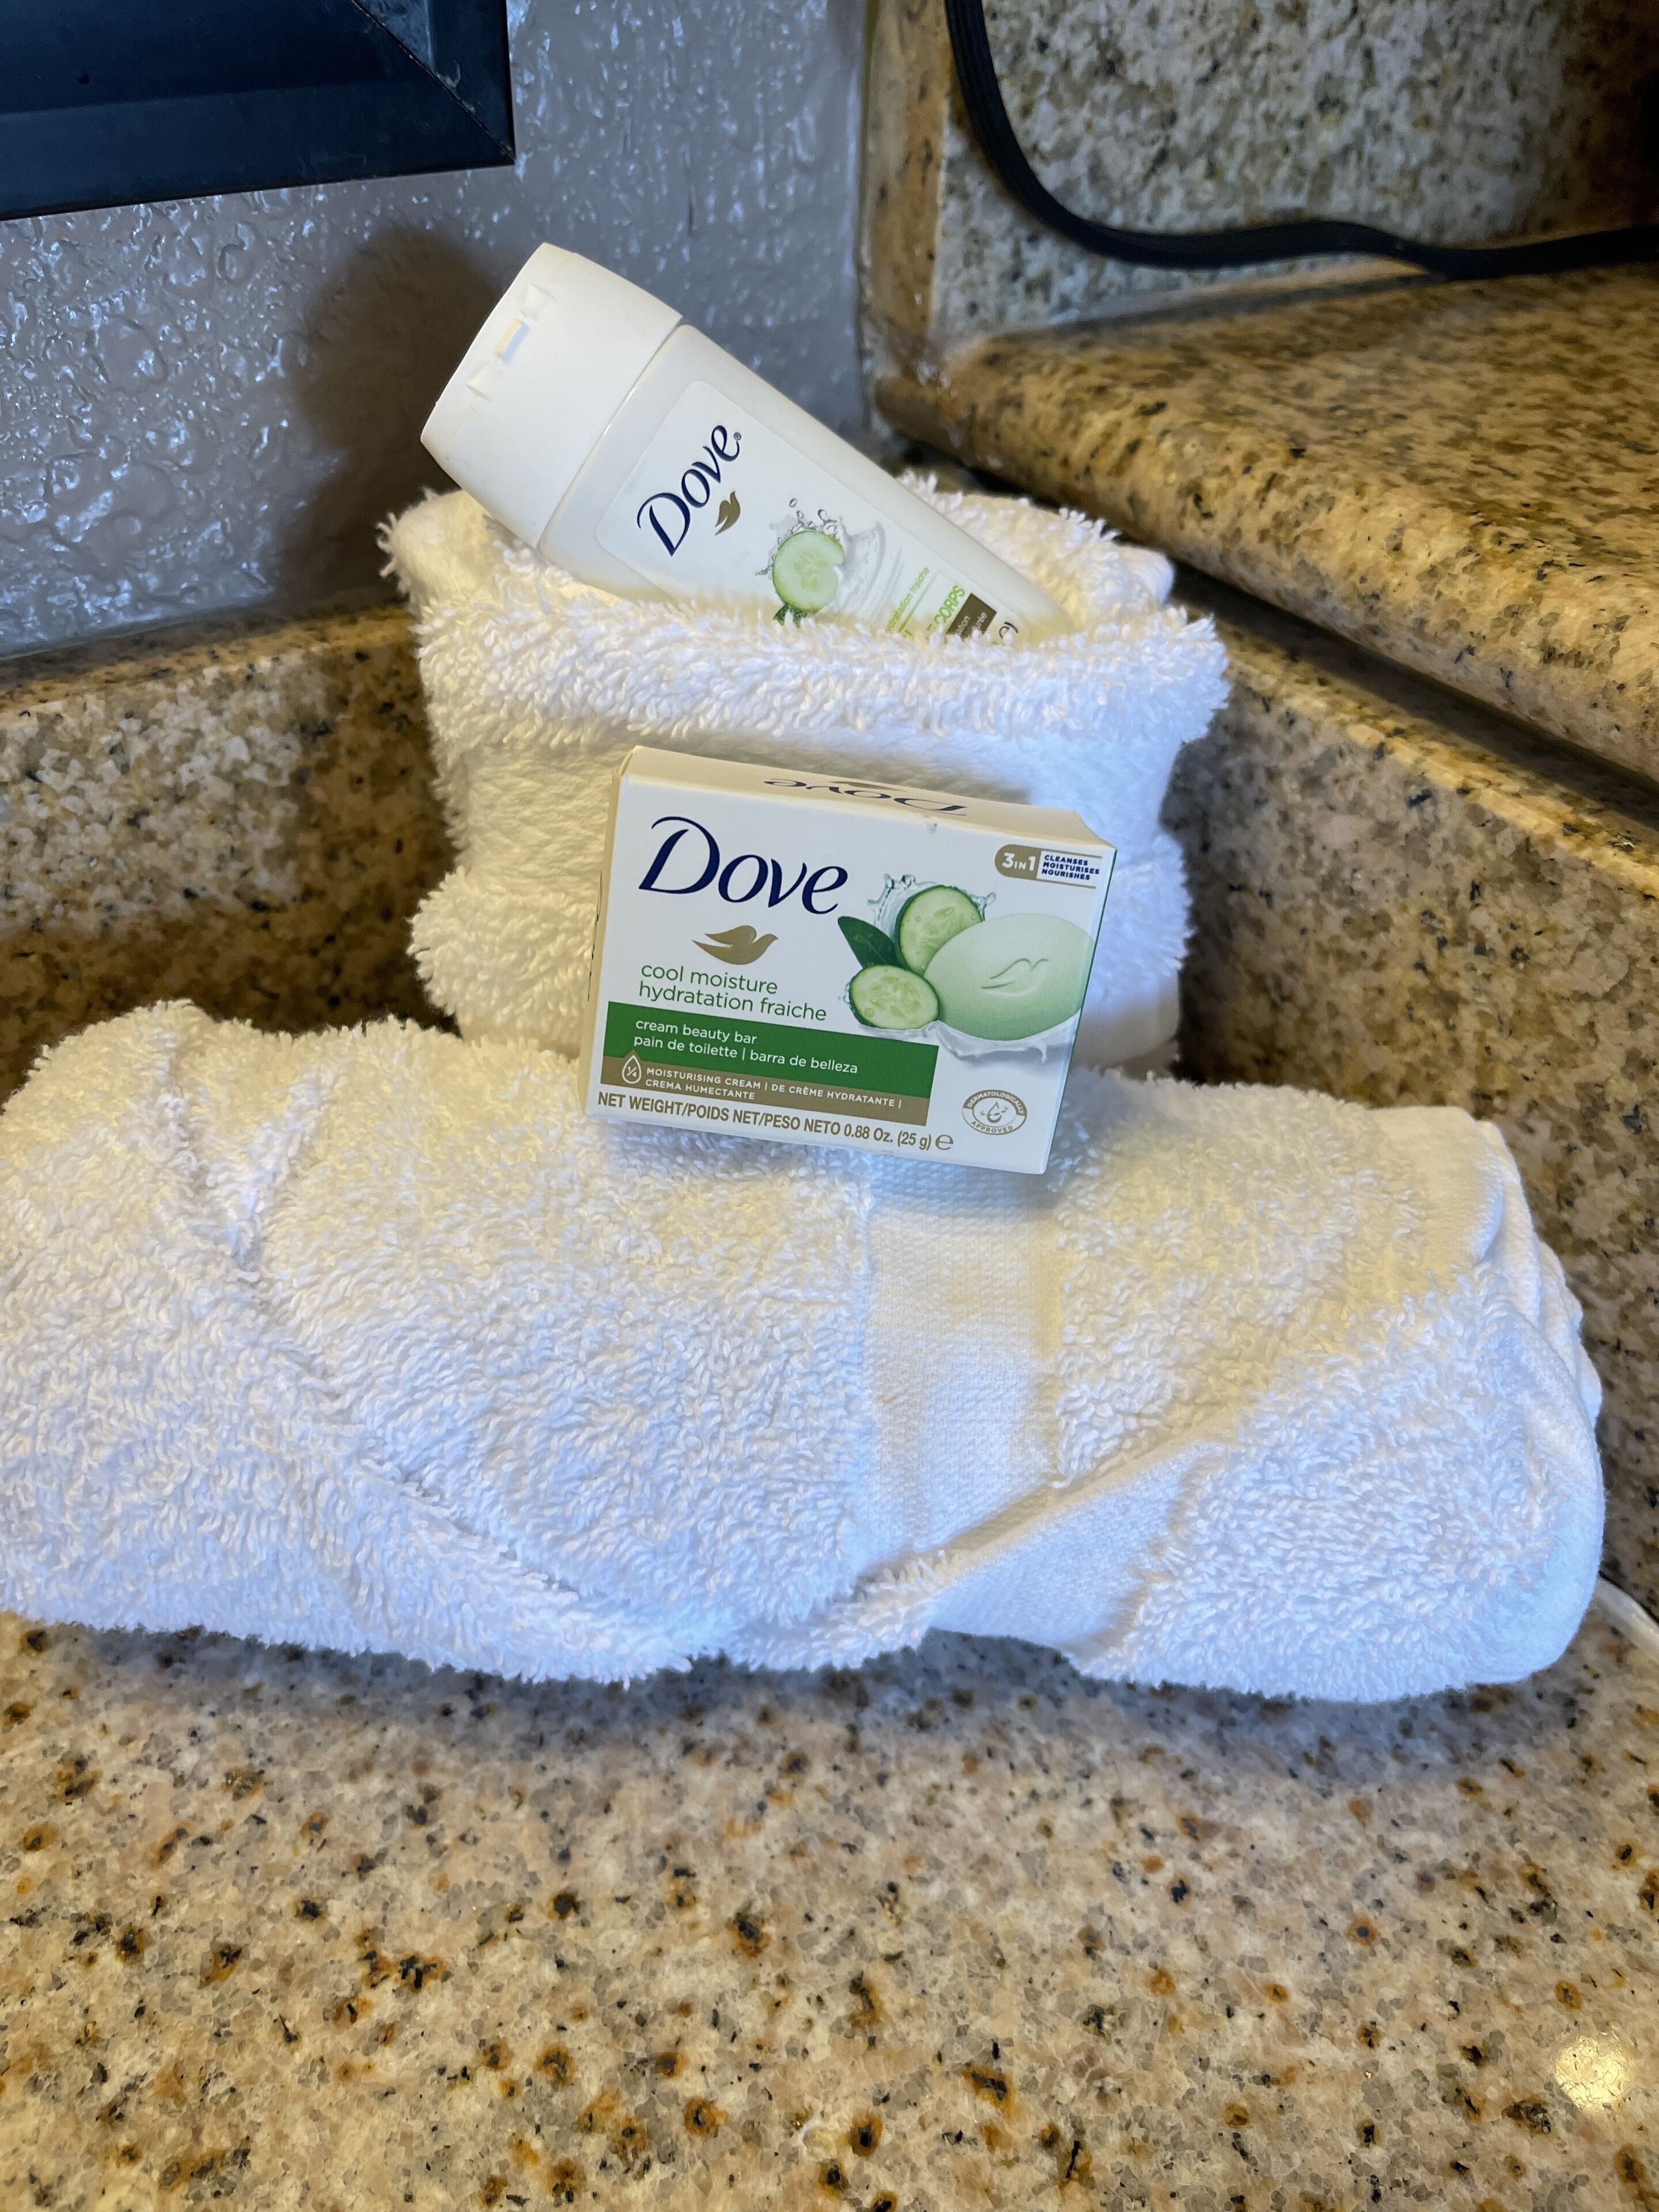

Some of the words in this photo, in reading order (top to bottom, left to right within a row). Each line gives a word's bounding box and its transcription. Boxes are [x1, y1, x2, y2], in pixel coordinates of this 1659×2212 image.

[885, 593, 913, 632] ydratation
[638, 816, 848, 915] Dove
[1043, 862, 1100, 874] MOISTURISES
[1044, 855, 1088, 866] CLEANSES
[1041, 869, 1090, 880] NOURISHES
[641, 965, 684, 982] cool
[691, 972, 778, 994] moisture
[639, 980, 753, 1012] hydratation
[760, 997, 827, 1021] fraiche
[635, 1020, 678, 1034] cream
[683, 1024, 730, 1043] beauty
[734, 1031, 757, 1044] bar
[634, 1036, 663, 1048] pain
[667, 1039, 685, 1051] de
[689, 1042, 738, 1058] toilette
[750, 1050, 785, 1065] barra
[789, 1055, 806, 1067] de
[810, 1057, 858, 1074] belleza
[645, 1079, 681, 1090] CREMA
[685, 1084, 756, 1100] HUMECTANTE
[646, 1067, 721, 1084] MOISTURISING
[725, 1078, 761, 1089] CREAM
[771, 1084, 785, 1092] DE
[789, 1086, 824, 1097] CRÈME
[827, 1091, 896, 1107] HYDRATANTE
[967, 1091, 1024, 1115] DERMATOLOGICALLY
[598, 1092, 626, 1108] NET
[629, 1095, 729, 1122] WEIGHT/POIDS
[733, 1109, 801, 1131] NET/PESO
[804, 1118, 840, 1135] NETO
[844, 1123, 870, 1139] 0.88
[873, 1127, 893, 1143] Oz.
[897, 1130, 917, 1147] (25
[919, 1134, 931, 1150] g)
[970, 1120, 1013, 1134] APPROVED
